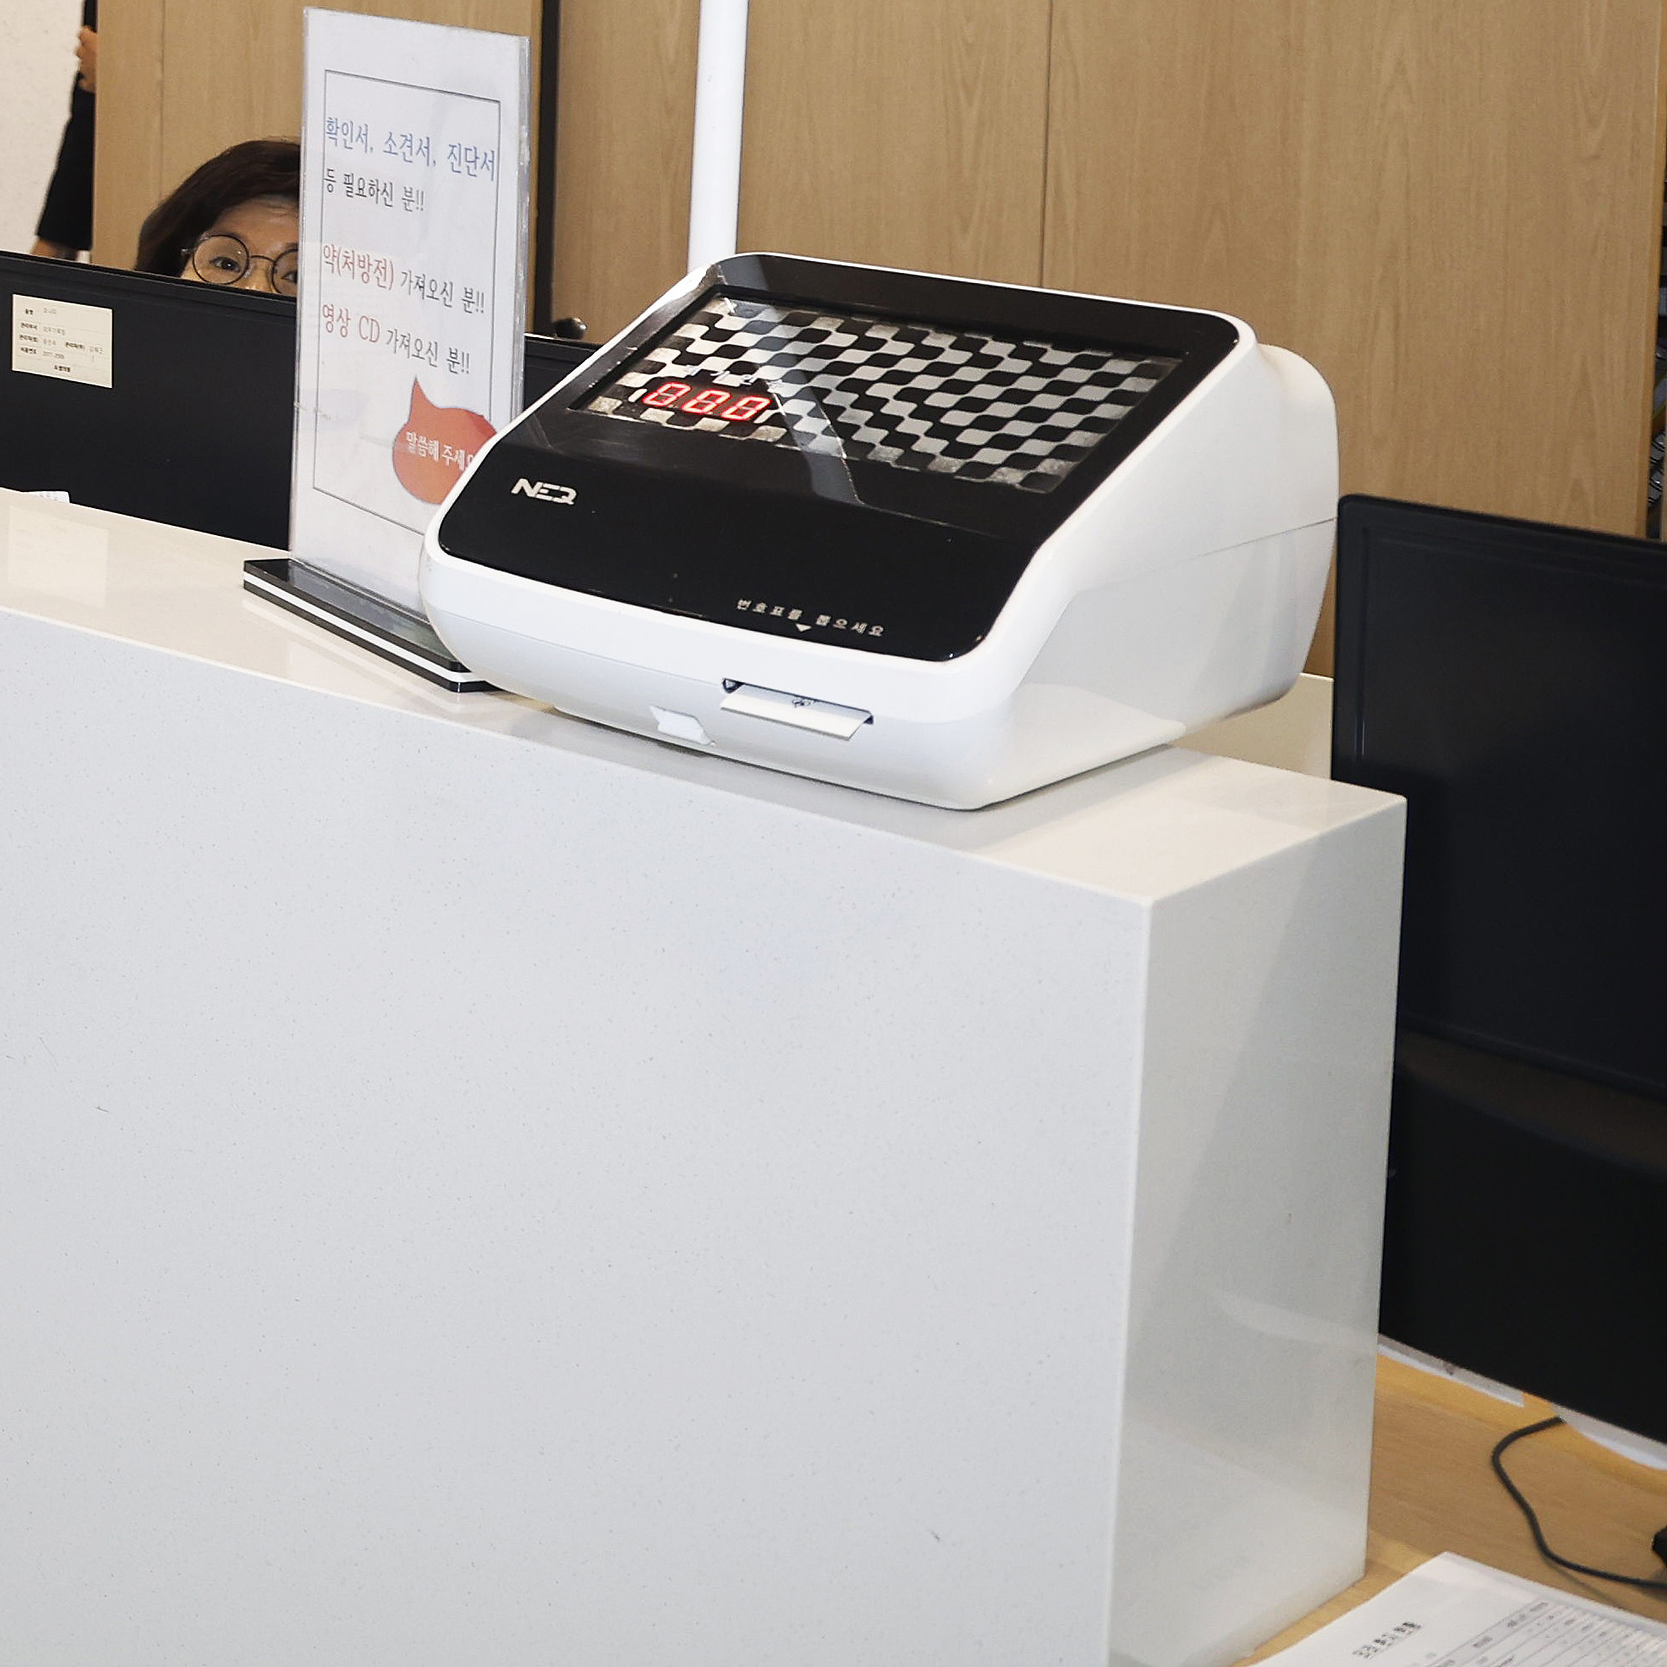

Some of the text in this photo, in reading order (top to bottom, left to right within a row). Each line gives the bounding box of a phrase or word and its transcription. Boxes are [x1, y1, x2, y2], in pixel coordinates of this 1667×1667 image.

[447, 142, 495, 182] 진단서
[324, 168, 425, 213] 등 필요하신 분!!
[323, 244, 485, 314] 약(처방전) 가져오신 분!!
[322, 303, 470, 374] 영상 CD 가져오신 분!!
[405, 431, 440, 462] 말씀해
[736, 598, 803, 621] 번호표를
